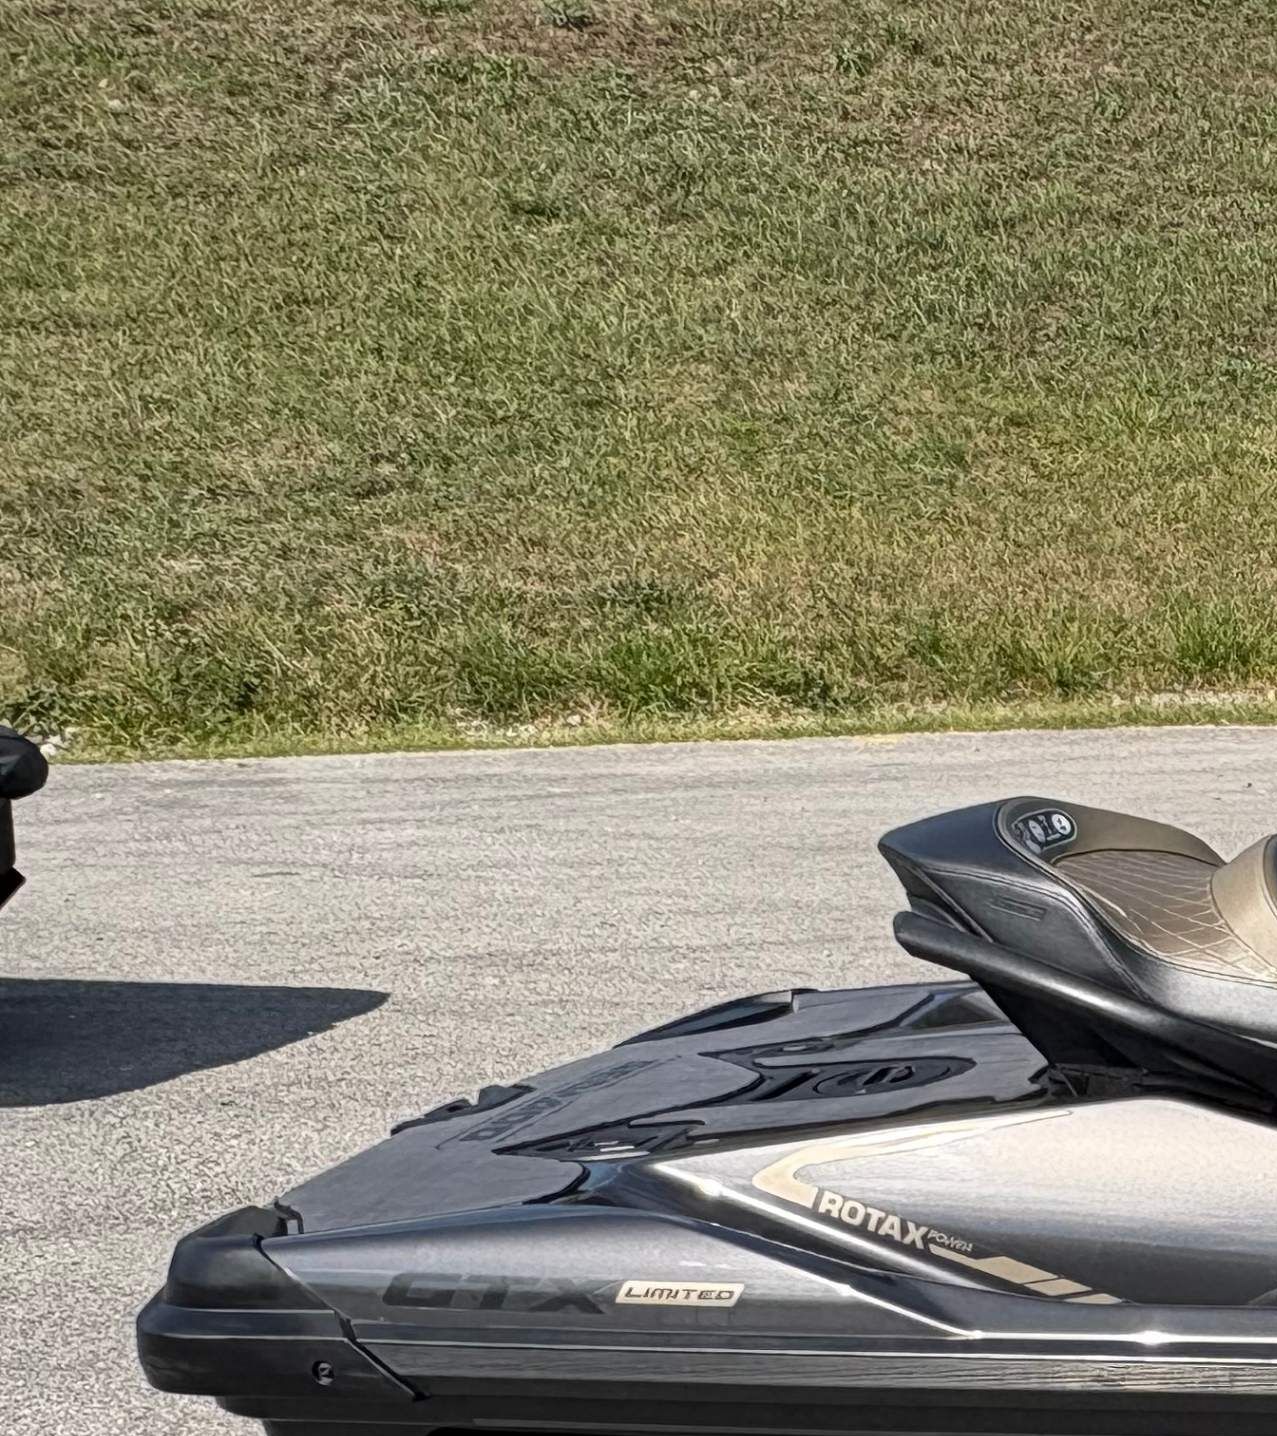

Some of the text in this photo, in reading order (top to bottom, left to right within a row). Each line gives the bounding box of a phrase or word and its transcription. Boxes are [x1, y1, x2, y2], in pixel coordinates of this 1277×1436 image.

[817, 1190, 929, 1250] ROTAX
[382, 1272, 735, 1314] GTX LIMITED
